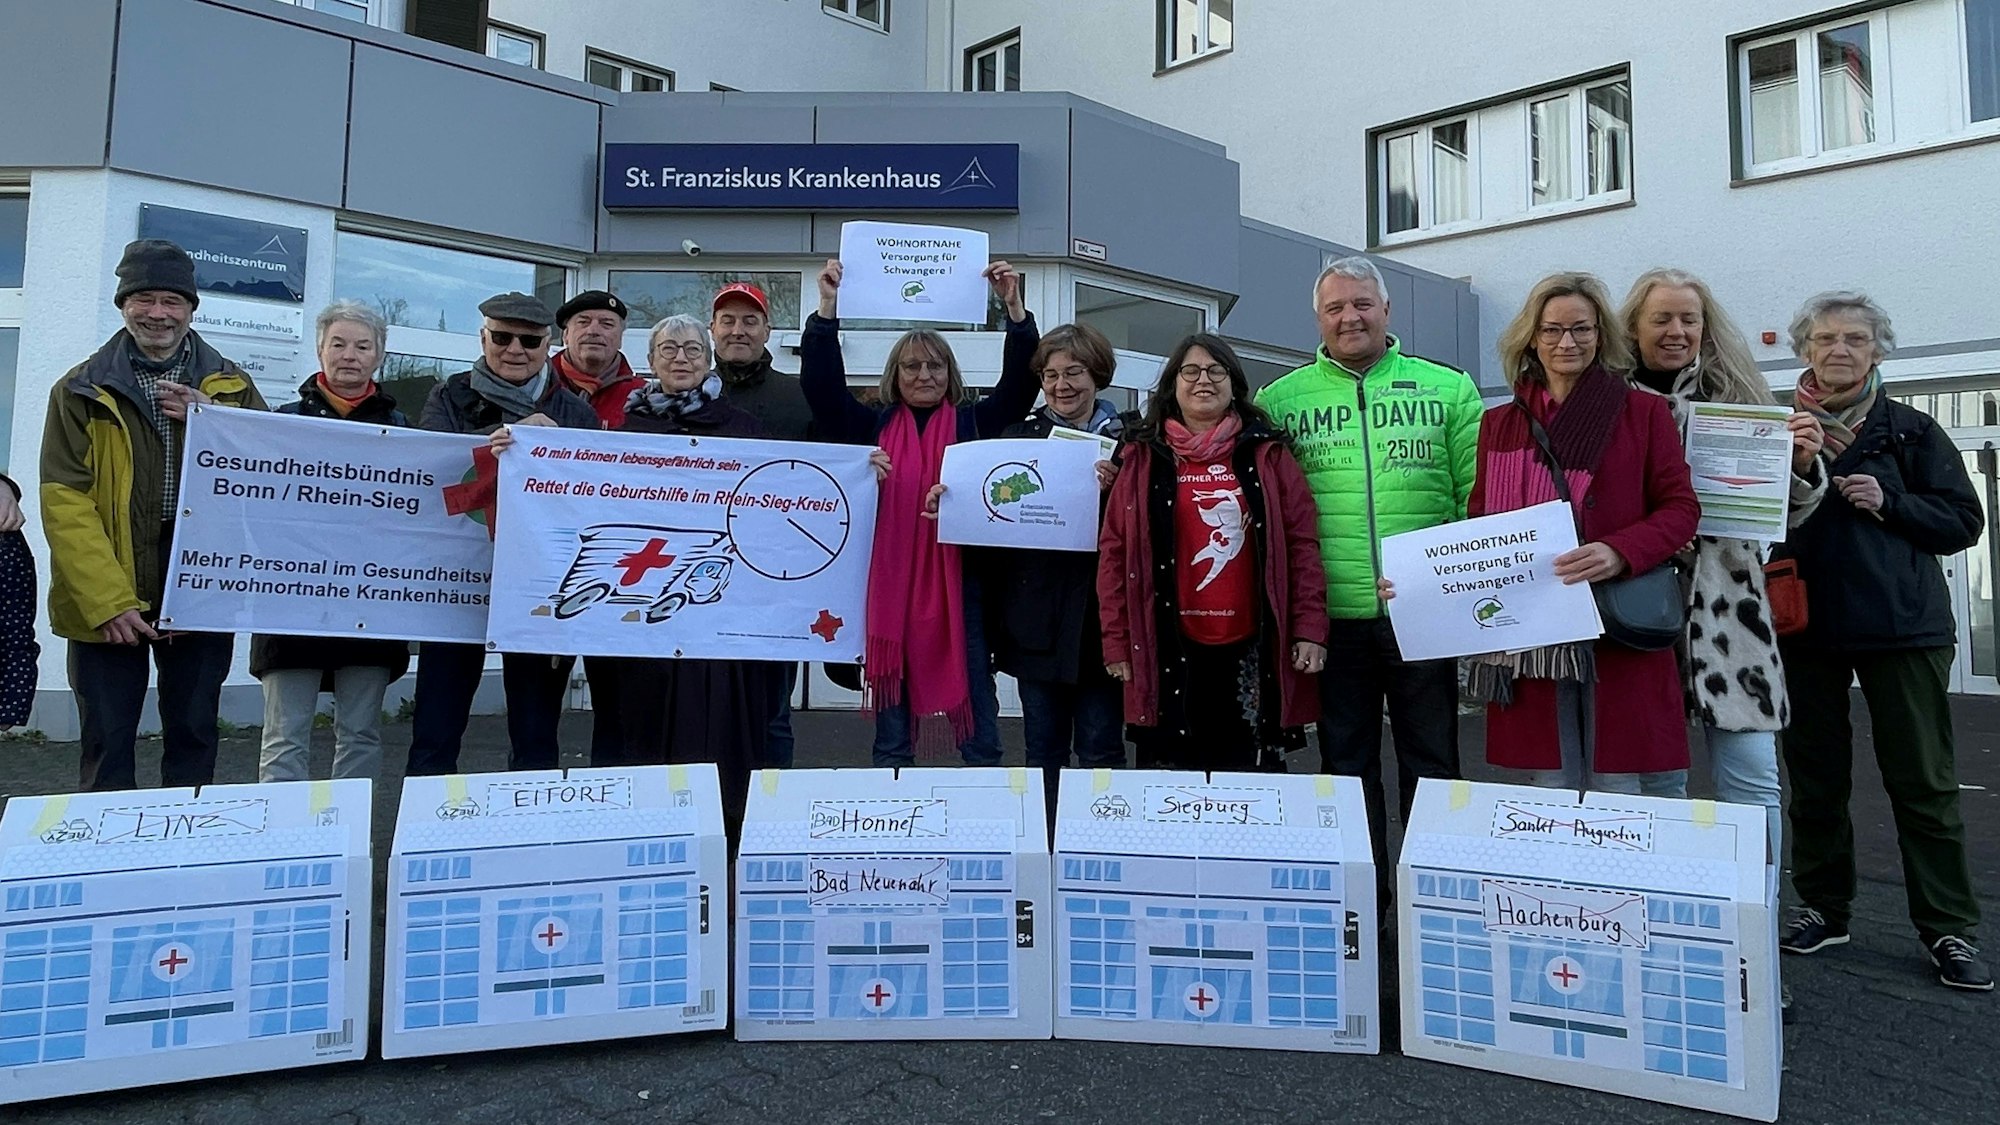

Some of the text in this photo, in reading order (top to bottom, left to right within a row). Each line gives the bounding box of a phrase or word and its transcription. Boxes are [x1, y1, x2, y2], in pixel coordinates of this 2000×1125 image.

[625, 167, 941, 189] St. Franziskus Krankenhaus
[876, 237, 962, 249] WOHNORTNAHE
[881, 251, 957, 263] Versorgung für
[883, 265, 946, 276] Schwangere
[224, 318, 294, 335] Krankenhaus
[1284, 400, 1444, 438] CAMP DAVID
[530, 446, 547, 458] 40
[549, 448, 571, 460] min
[573, 449, 618, 464] können
[619, 451, 715, 471] lebensgefährlich
[716, 460, 742, 472] sein
[1387, 439, 1432, 460] 25/01
[196, 450, 435, 486] Gesundheitsbündnis
[213, 478, 420, 515] Bonn / Rhein-Sieg
[523, 478, 840, 513] Rettet die Geburtshilfe im Rhein-Sieg-Kreis!
[1424, 529, 1539, 559] WOHNORTNAHE
[180, 550, 234, 569] Mehr
[239, 553, 328, 575] Personal
[333, 559, 356, 577] im
[1433, 551, 1535, 576] Versorgung für
[177, 571, 213, 591] Für
[218, 576, 350, 599] wohnortnahe
[1441, 569, 1535, 595] Schwangere !
[513, 784, 616, 808] EITORF
[841, 805, 924, 837] Honnef
[1157, 796, 1250, 825] Siegburg
[134, 811, 228, 838] LINZ
[1499, 812, 1642, 846] Sankt Augustin
[811, 867, 939, 894] Bad Neuenahr
[1495, 892, 1622, 943] Hachenburg
[1017, 933, 1033, 944] 5+
